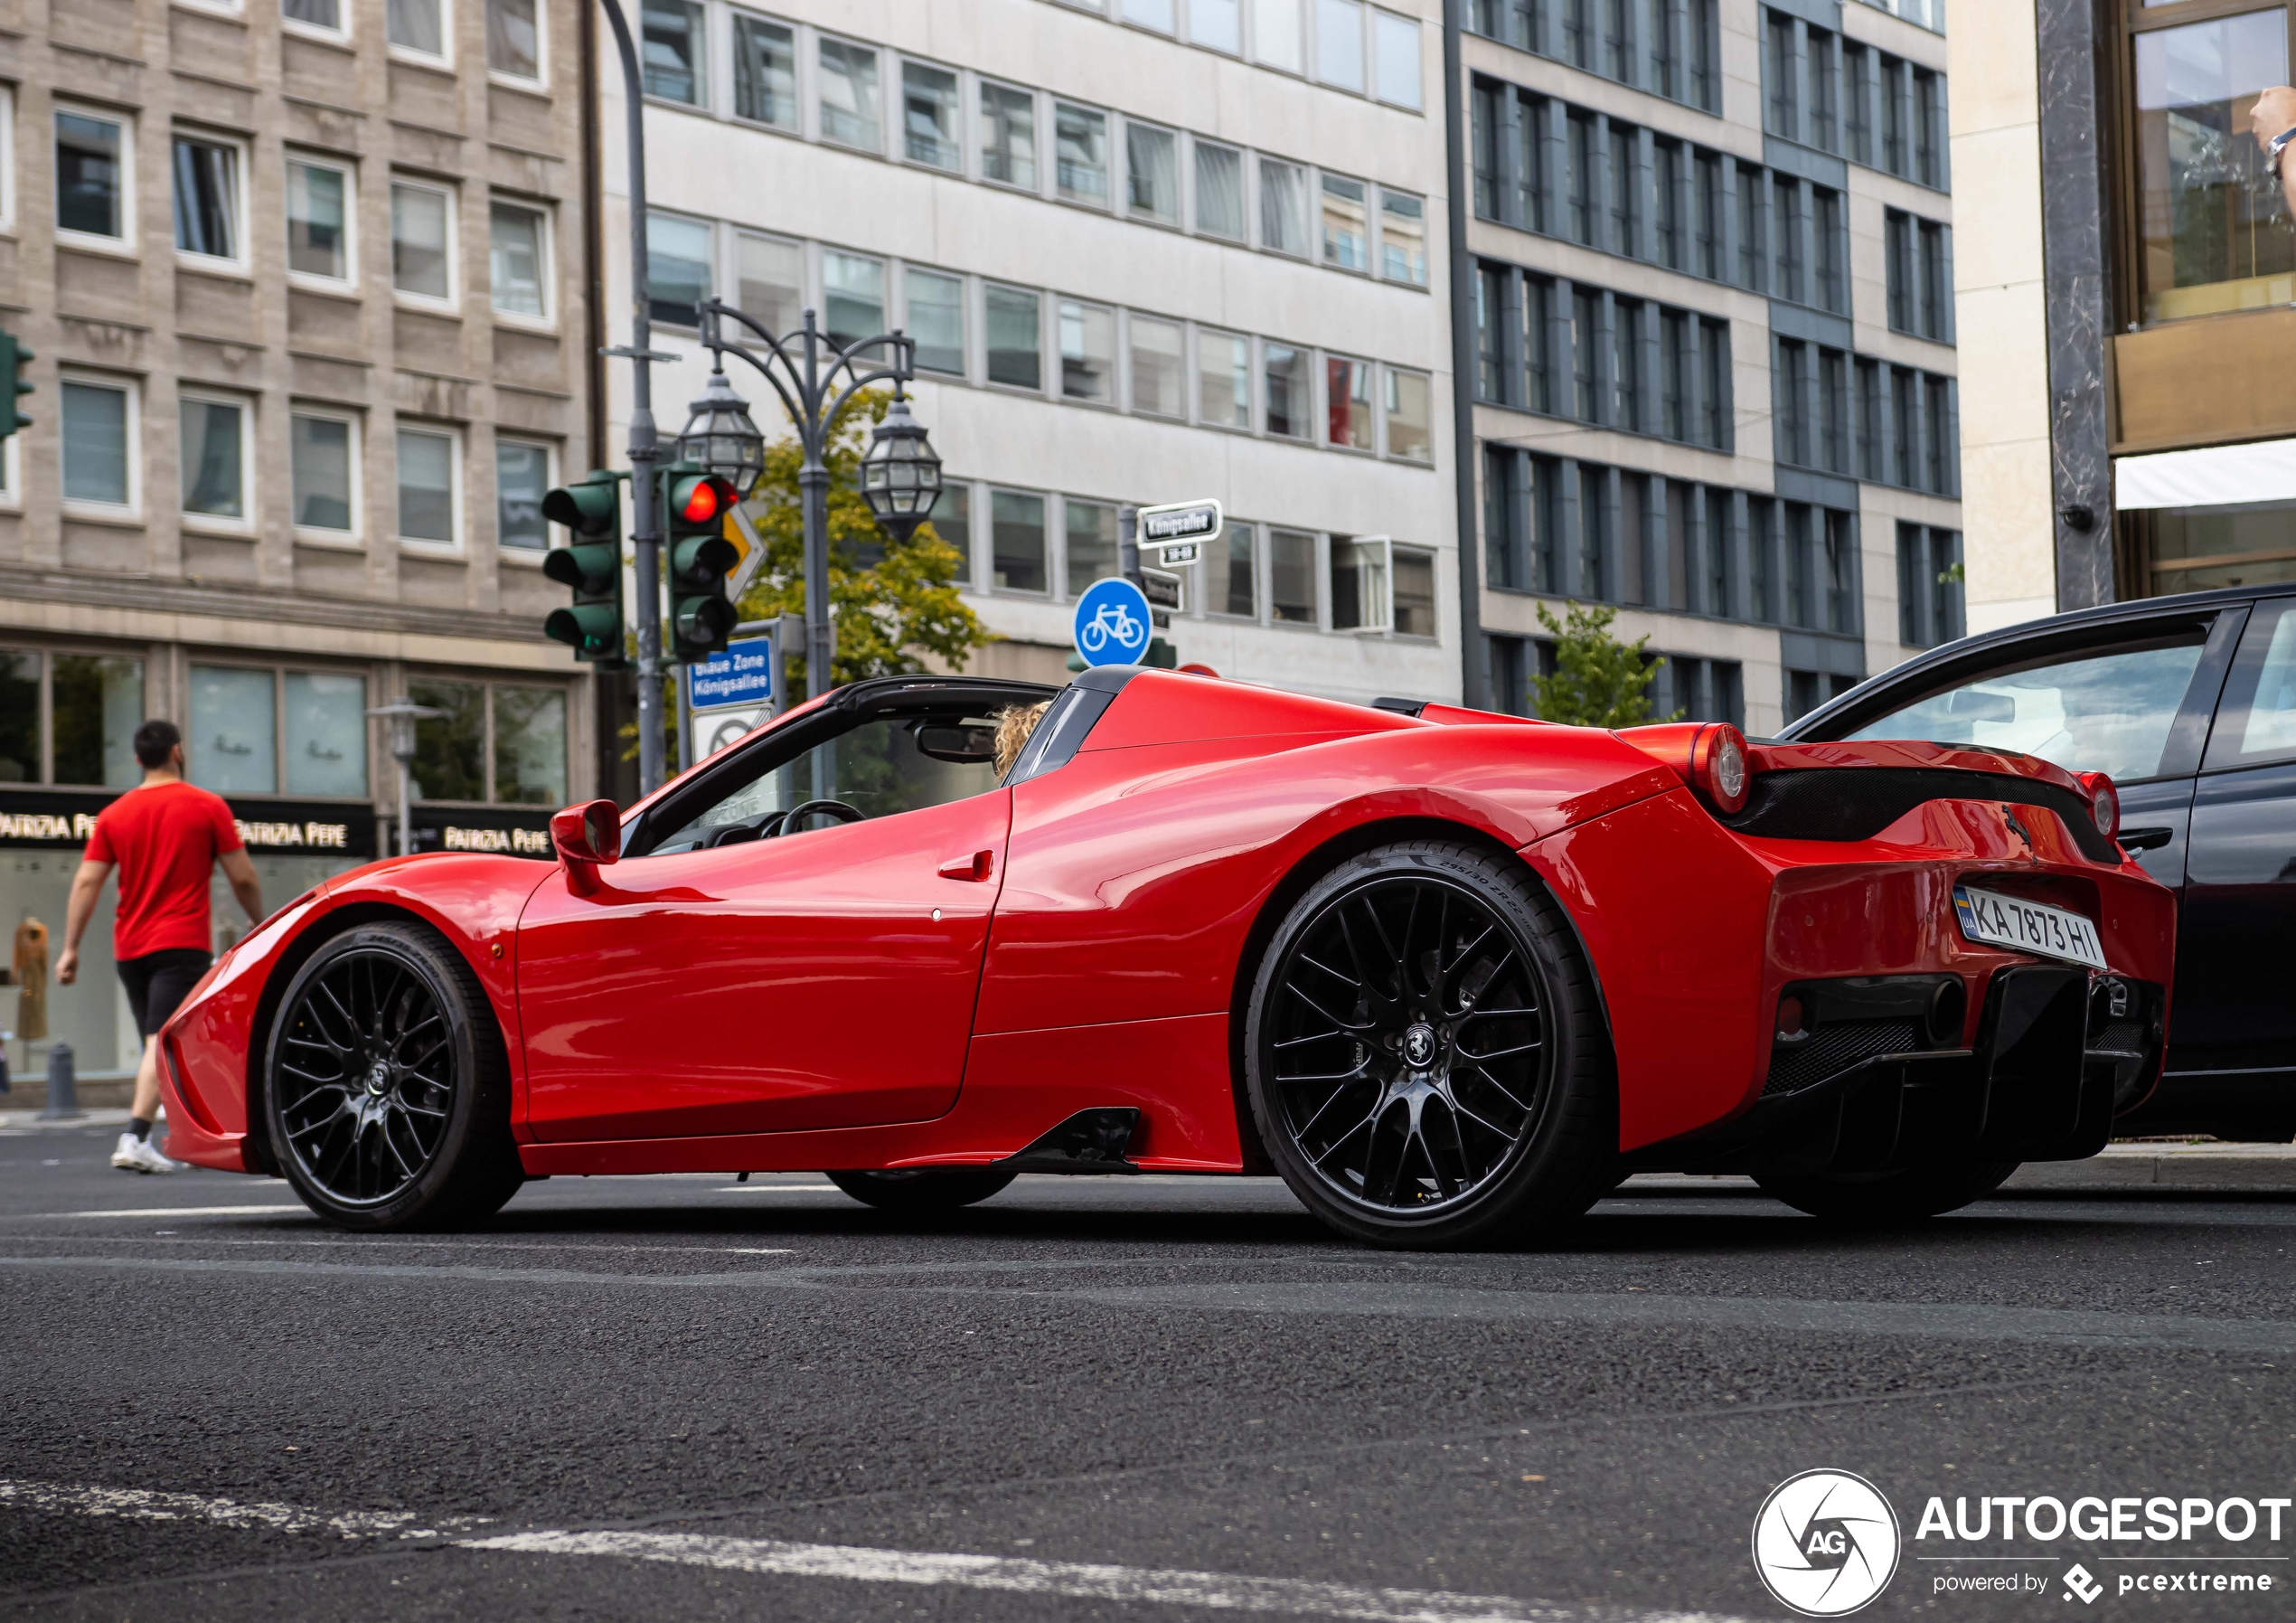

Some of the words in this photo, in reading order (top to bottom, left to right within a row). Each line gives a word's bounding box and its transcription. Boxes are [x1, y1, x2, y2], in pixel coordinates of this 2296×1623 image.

[1147, 512, 1209, 535] Königsallee
[694, 659, 730, 676] Blaue
[733, 654, 765, 671] Zone
[694, 673, 767, 696] Königsallee
[0, 813, 71, 839] ATRIZIA
[306, 821, 347, 847] PEPE
[445, 826, 511, 852] PATRIZIA
[513, 827, 549, 853] PEPE
[1439, 860, 1489, 884] 295/30
[1489, 885, 1524, 915] ZR22
[1962, 918, 1977, 930] UA
[1970, 894, 2013, 939] KA
[2009, 904, 2066, 951] 7873
[2065, 918, 2097, 961] HI
